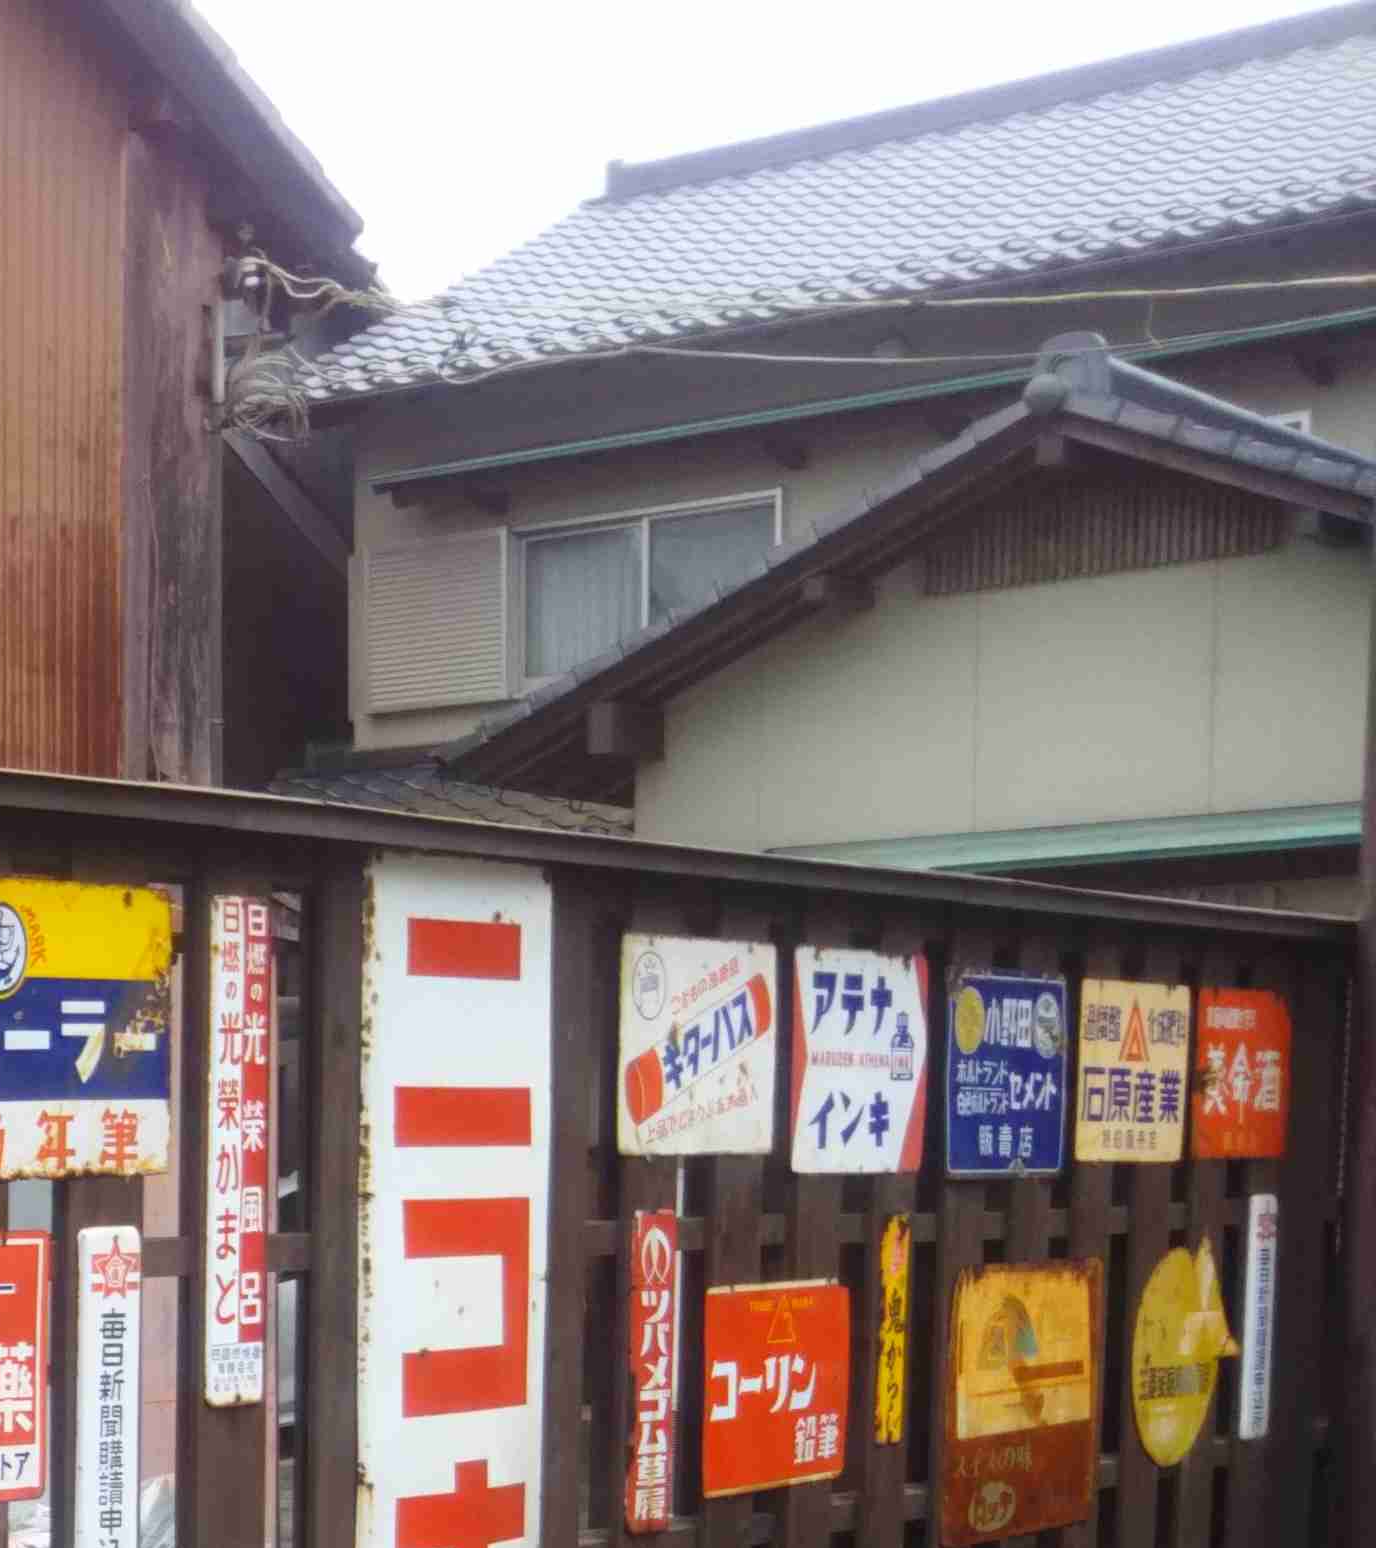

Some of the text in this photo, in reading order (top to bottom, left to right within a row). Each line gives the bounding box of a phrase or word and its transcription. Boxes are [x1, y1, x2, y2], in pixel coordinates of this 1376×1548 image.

[811, 971, 893, 1036] アテナ
[809, 1092, 889, 1149] インキ
[1082, 1067, 1180, 1123] 石原産業
[710, 1354, 817, 1421] コーリン
[793, 1413, 840, 1464] 鉛筆
